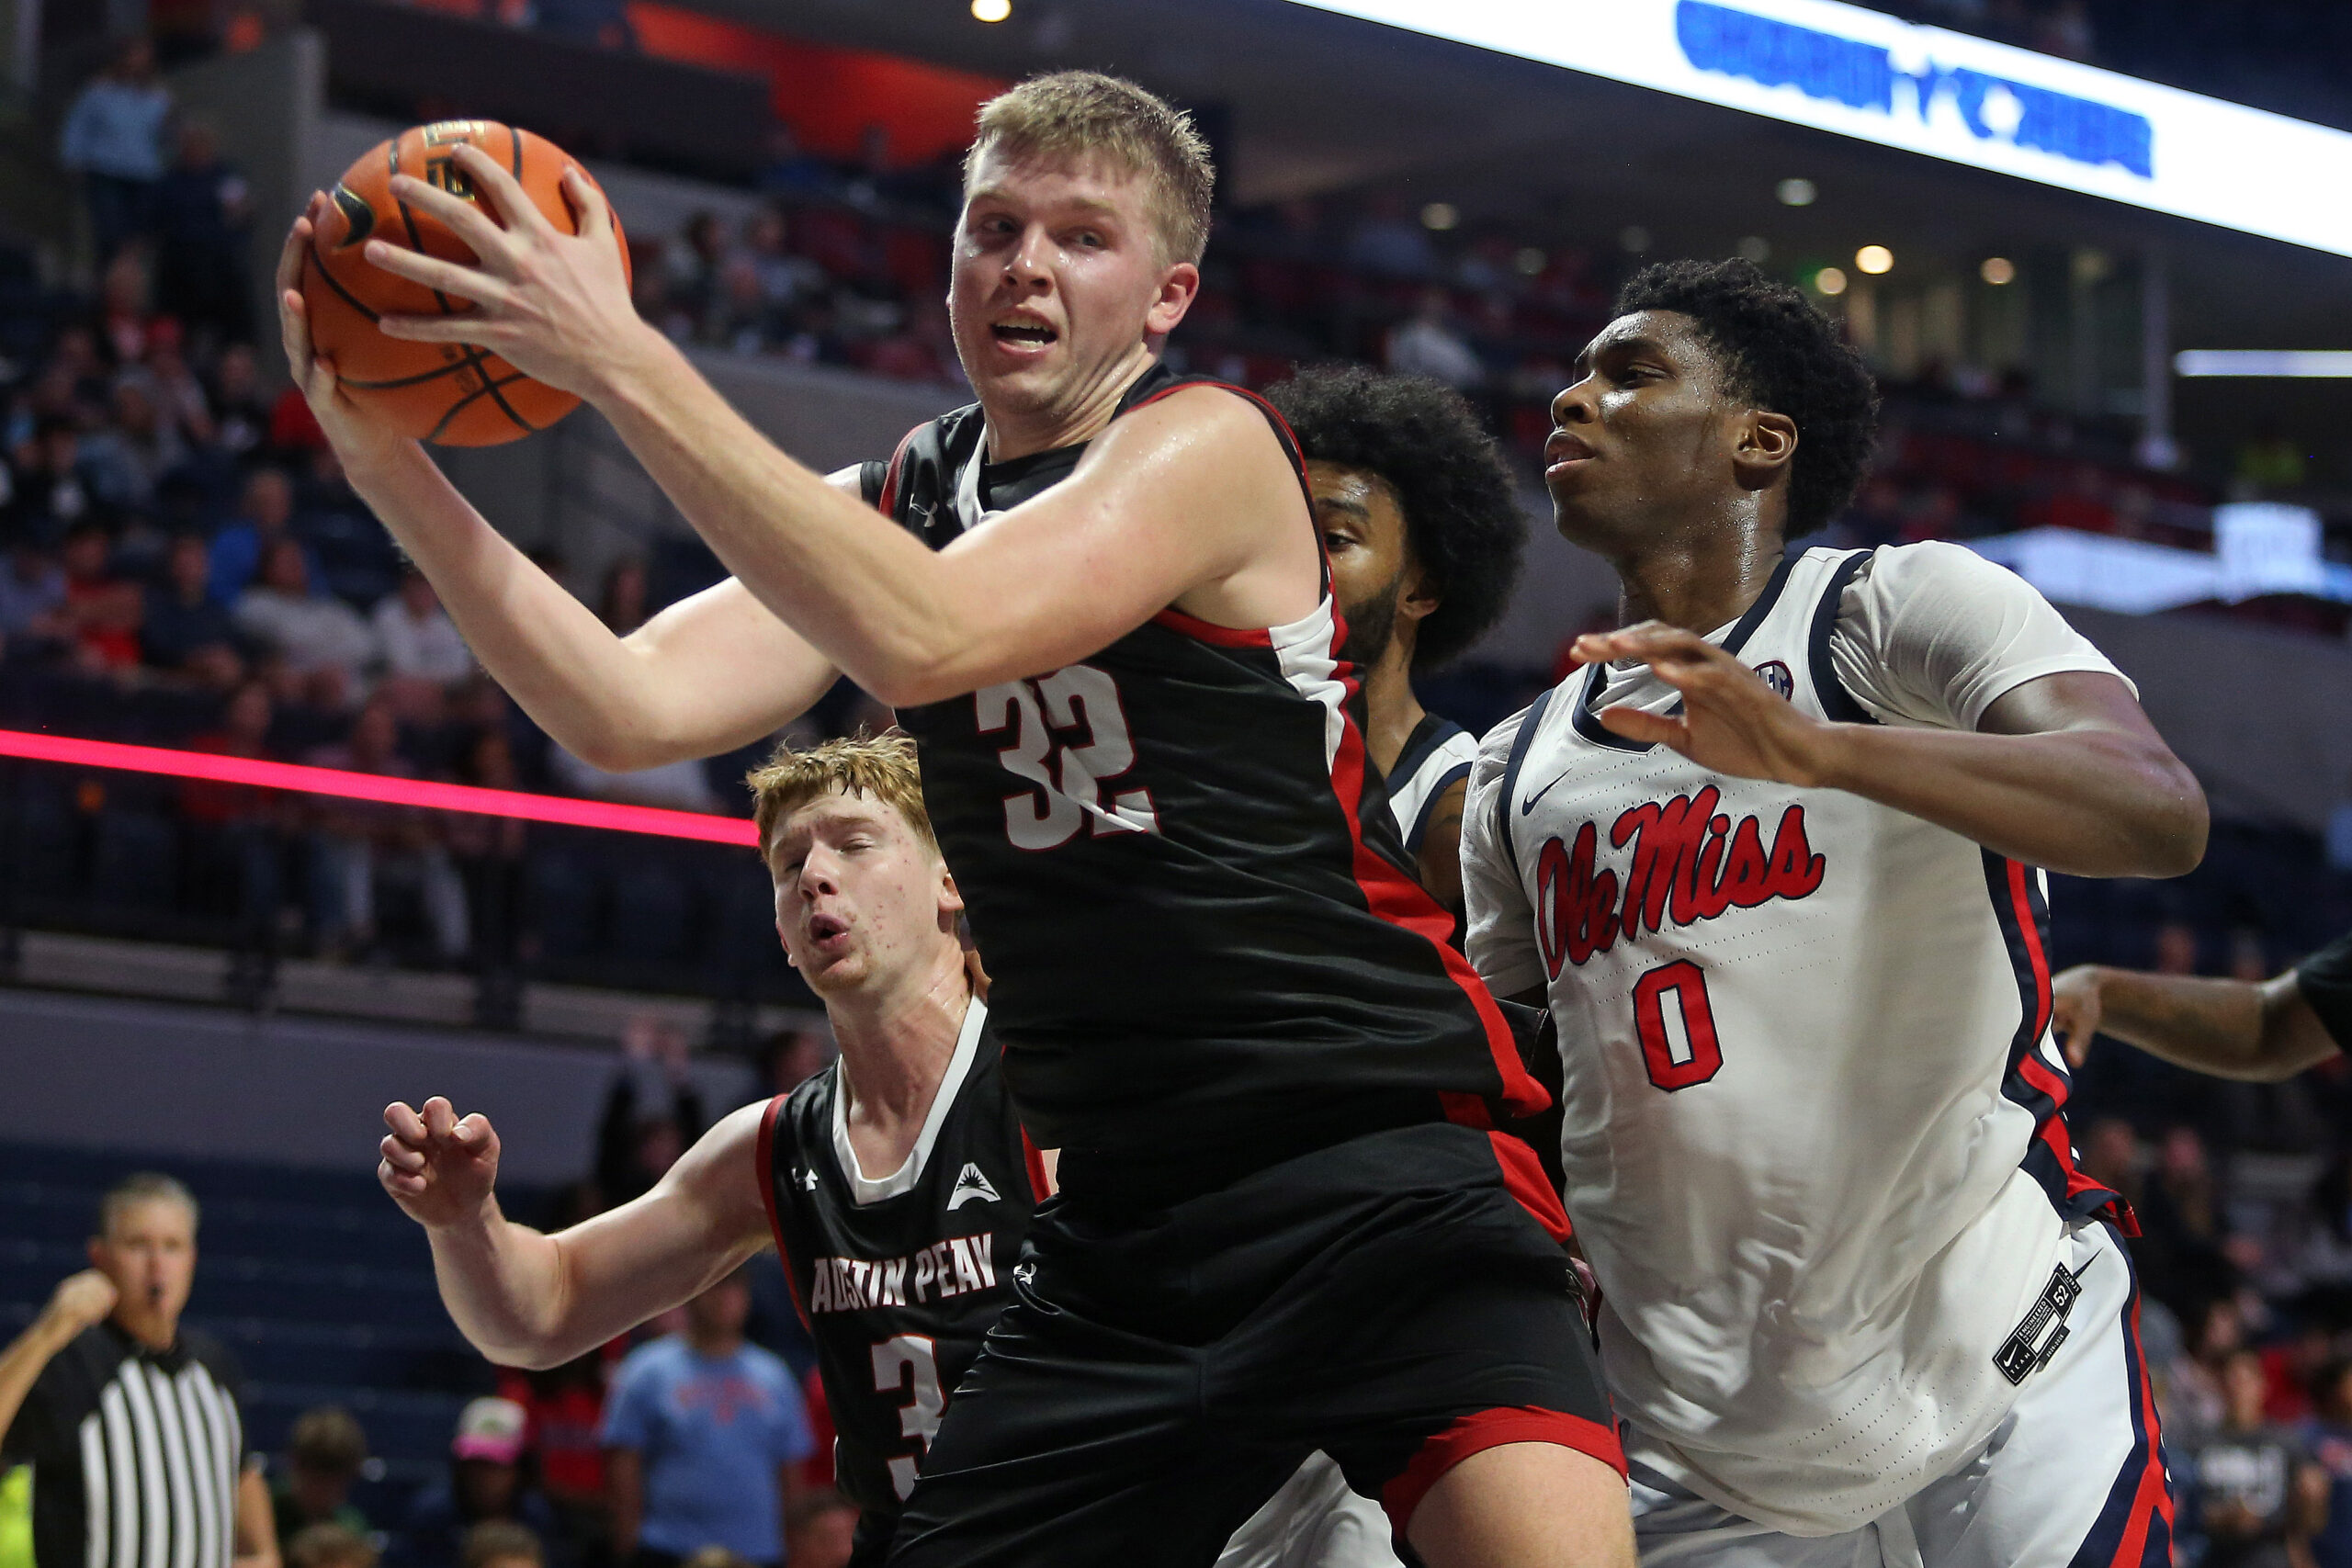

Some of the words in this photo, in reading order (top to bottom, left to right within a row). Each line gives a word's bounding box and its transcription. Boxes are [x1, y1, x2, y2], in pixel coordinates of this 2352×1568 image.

[975, 664, 1161, 852] 32
[1537, 820, 1619, 981] Ole
[1611, 784, 1826, 942] Miss
[1633, 958, 1724, 1093] 0
[915, 1232, 997, 1303] PEAY
[2018, 1301, 2048, 1337] ENGINEERED
[2052, 1284, 2070, 1306] 52
[2010, 1352, 2030, 1374] TEAM
[870, 1332, 948, 1503] 3
